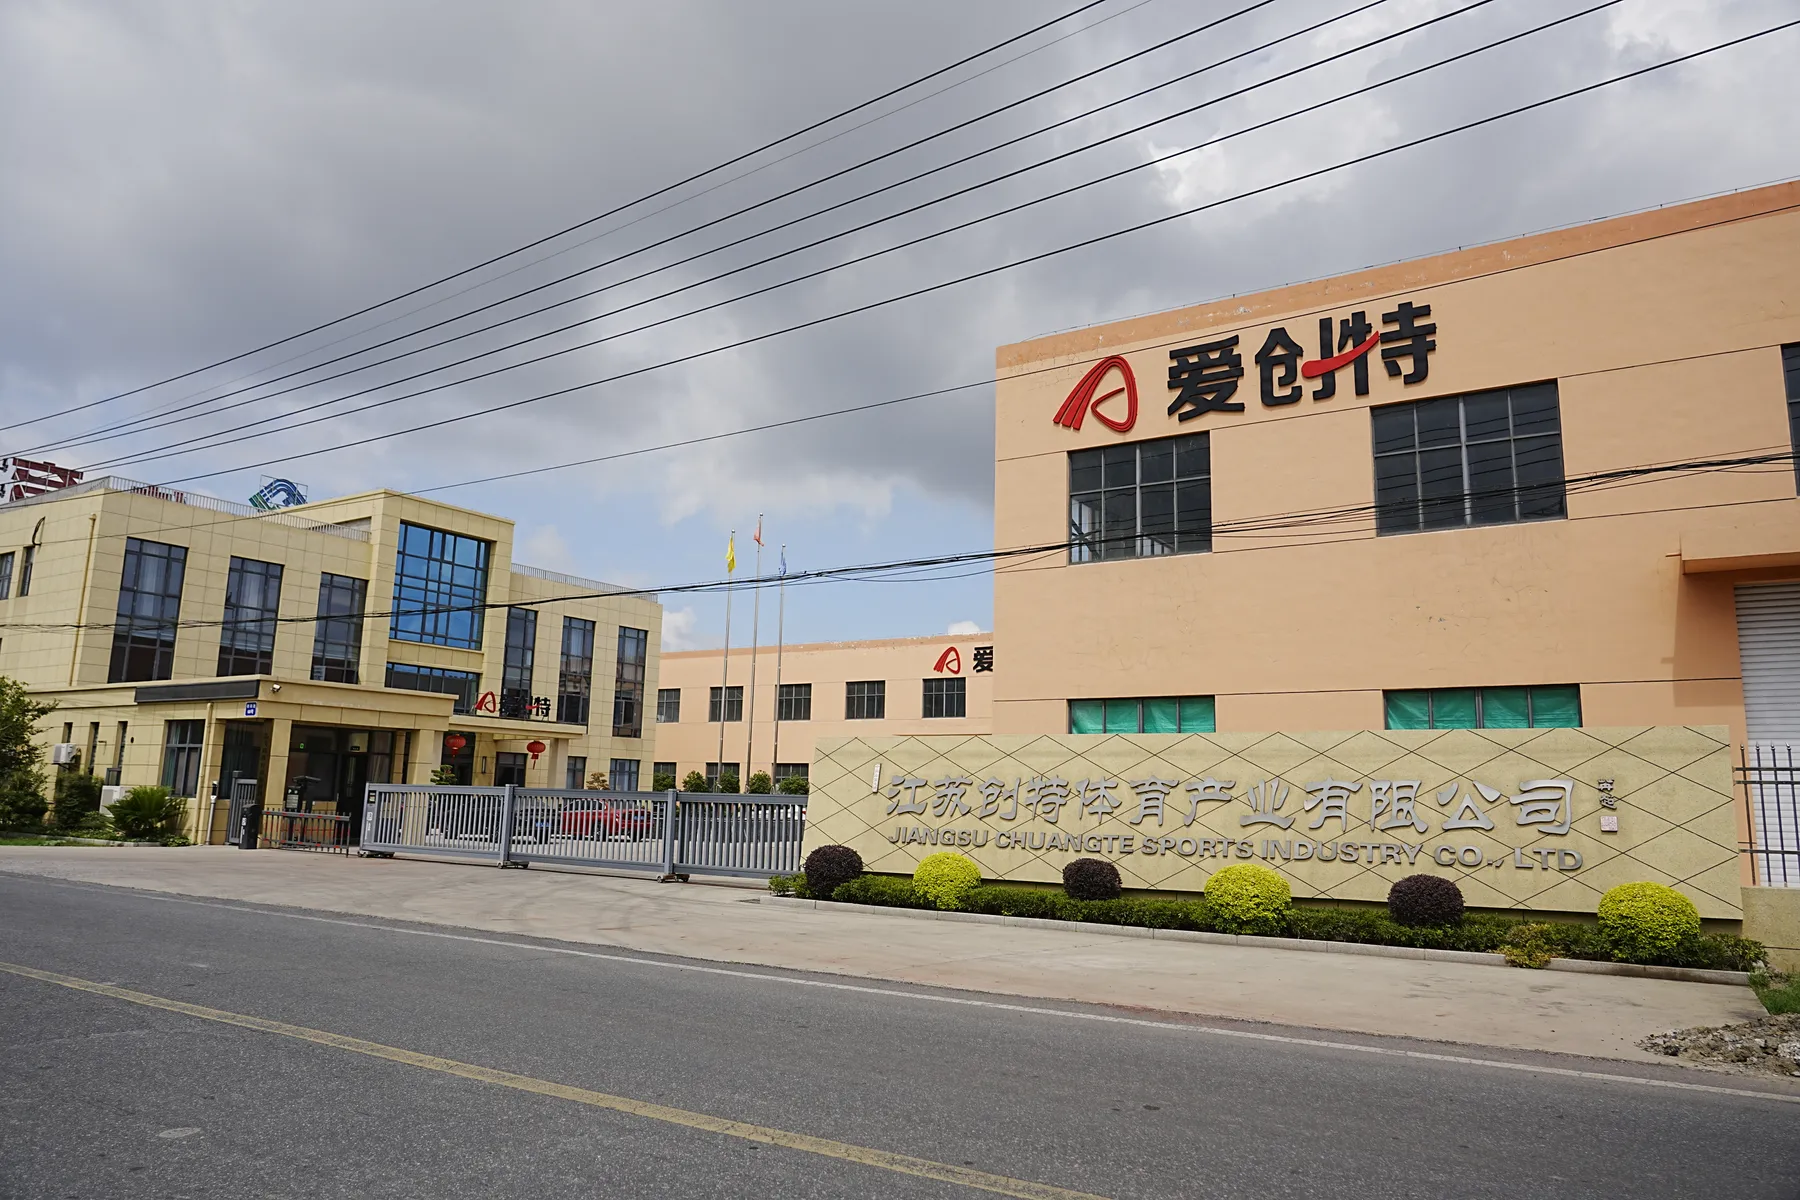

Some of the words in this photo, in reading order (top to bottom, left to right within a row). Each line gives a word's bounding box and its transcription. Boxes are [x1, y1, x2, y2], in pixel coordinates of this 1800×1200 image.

[1167, 300, 1437, 423] 爱创特
[887, 774, 1574, 836] 江苏创特体育产业有限公司
[888, 826, 989, 847] JIANGSU
[995, 831, 1134, 854] CHUANGTE
[1141, 835, 1253, 859] SPORTS
[1261, 839, 1423, 865] INDUSTRY
[1434, 845, 1504, 868] CO.,
[1514, 847, 1584, 871] LTD
